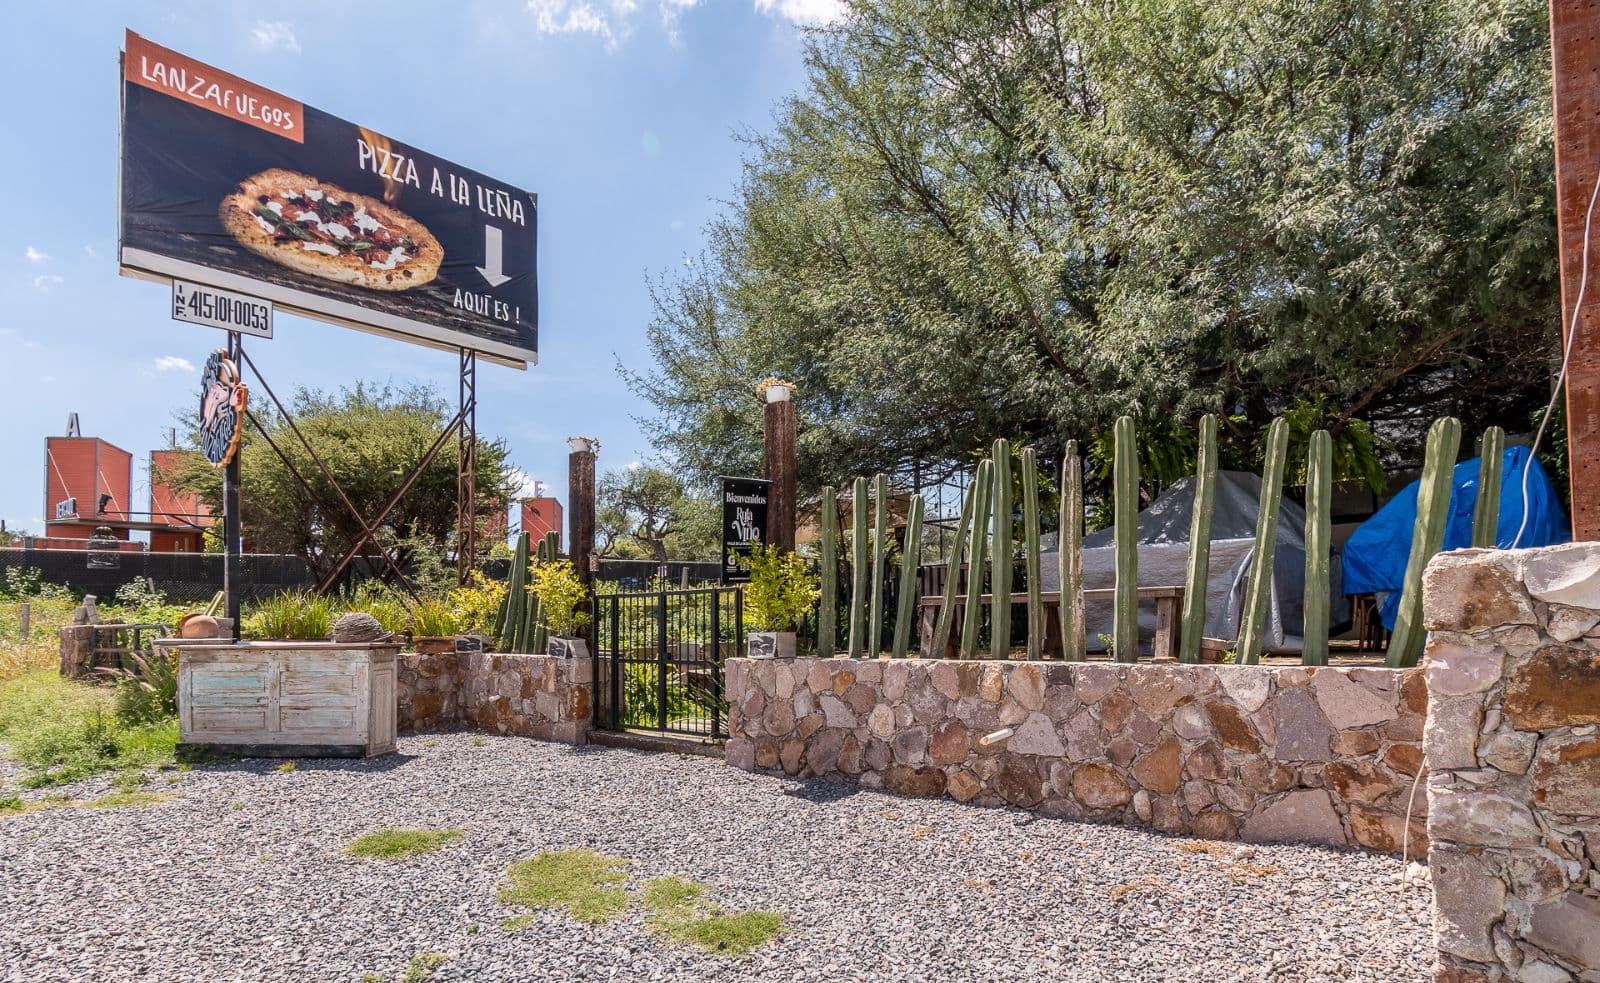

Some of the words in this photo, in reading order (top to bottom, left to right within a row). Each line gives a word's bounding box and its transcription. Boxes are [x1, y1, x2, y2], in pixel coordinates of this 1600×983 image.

[141, 55, 295, 130] LANZAFUEGOS
[357, 138, 420, 189] PIZZA
[430, 167, 444, 197] A
[450, 173, 470, 206] LA
[477, 184, 525, 226] LEÑA
[494, 299, 509, 321] ES
[726, 492, 766, 504] Bienvenidos
